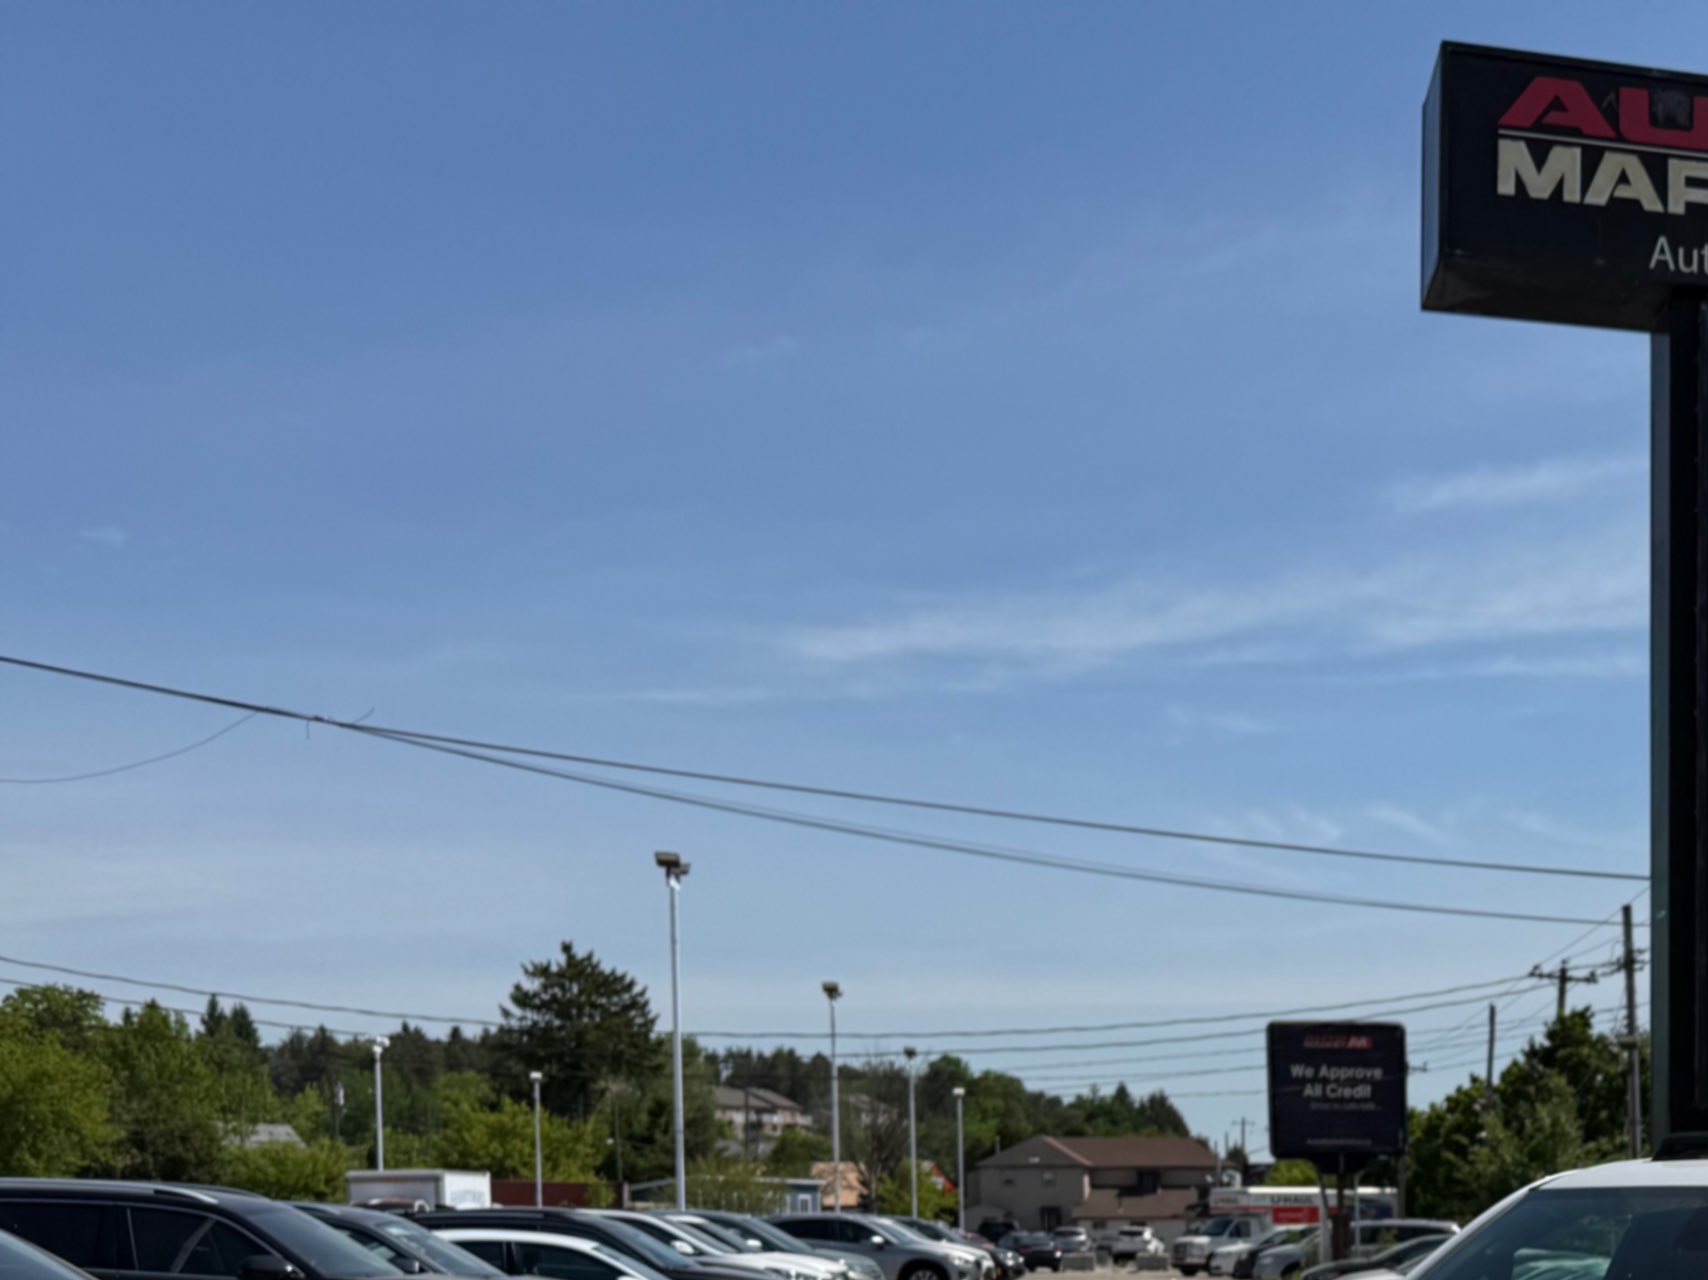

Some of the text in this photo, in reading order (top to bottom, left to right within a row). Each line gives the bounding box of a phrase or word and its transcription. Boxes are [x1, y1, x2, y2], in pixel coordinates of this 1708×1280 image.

[1289, 1063, 1384, 1081] We Approve
[1302, 1083, 1372, 1099] All Credit
